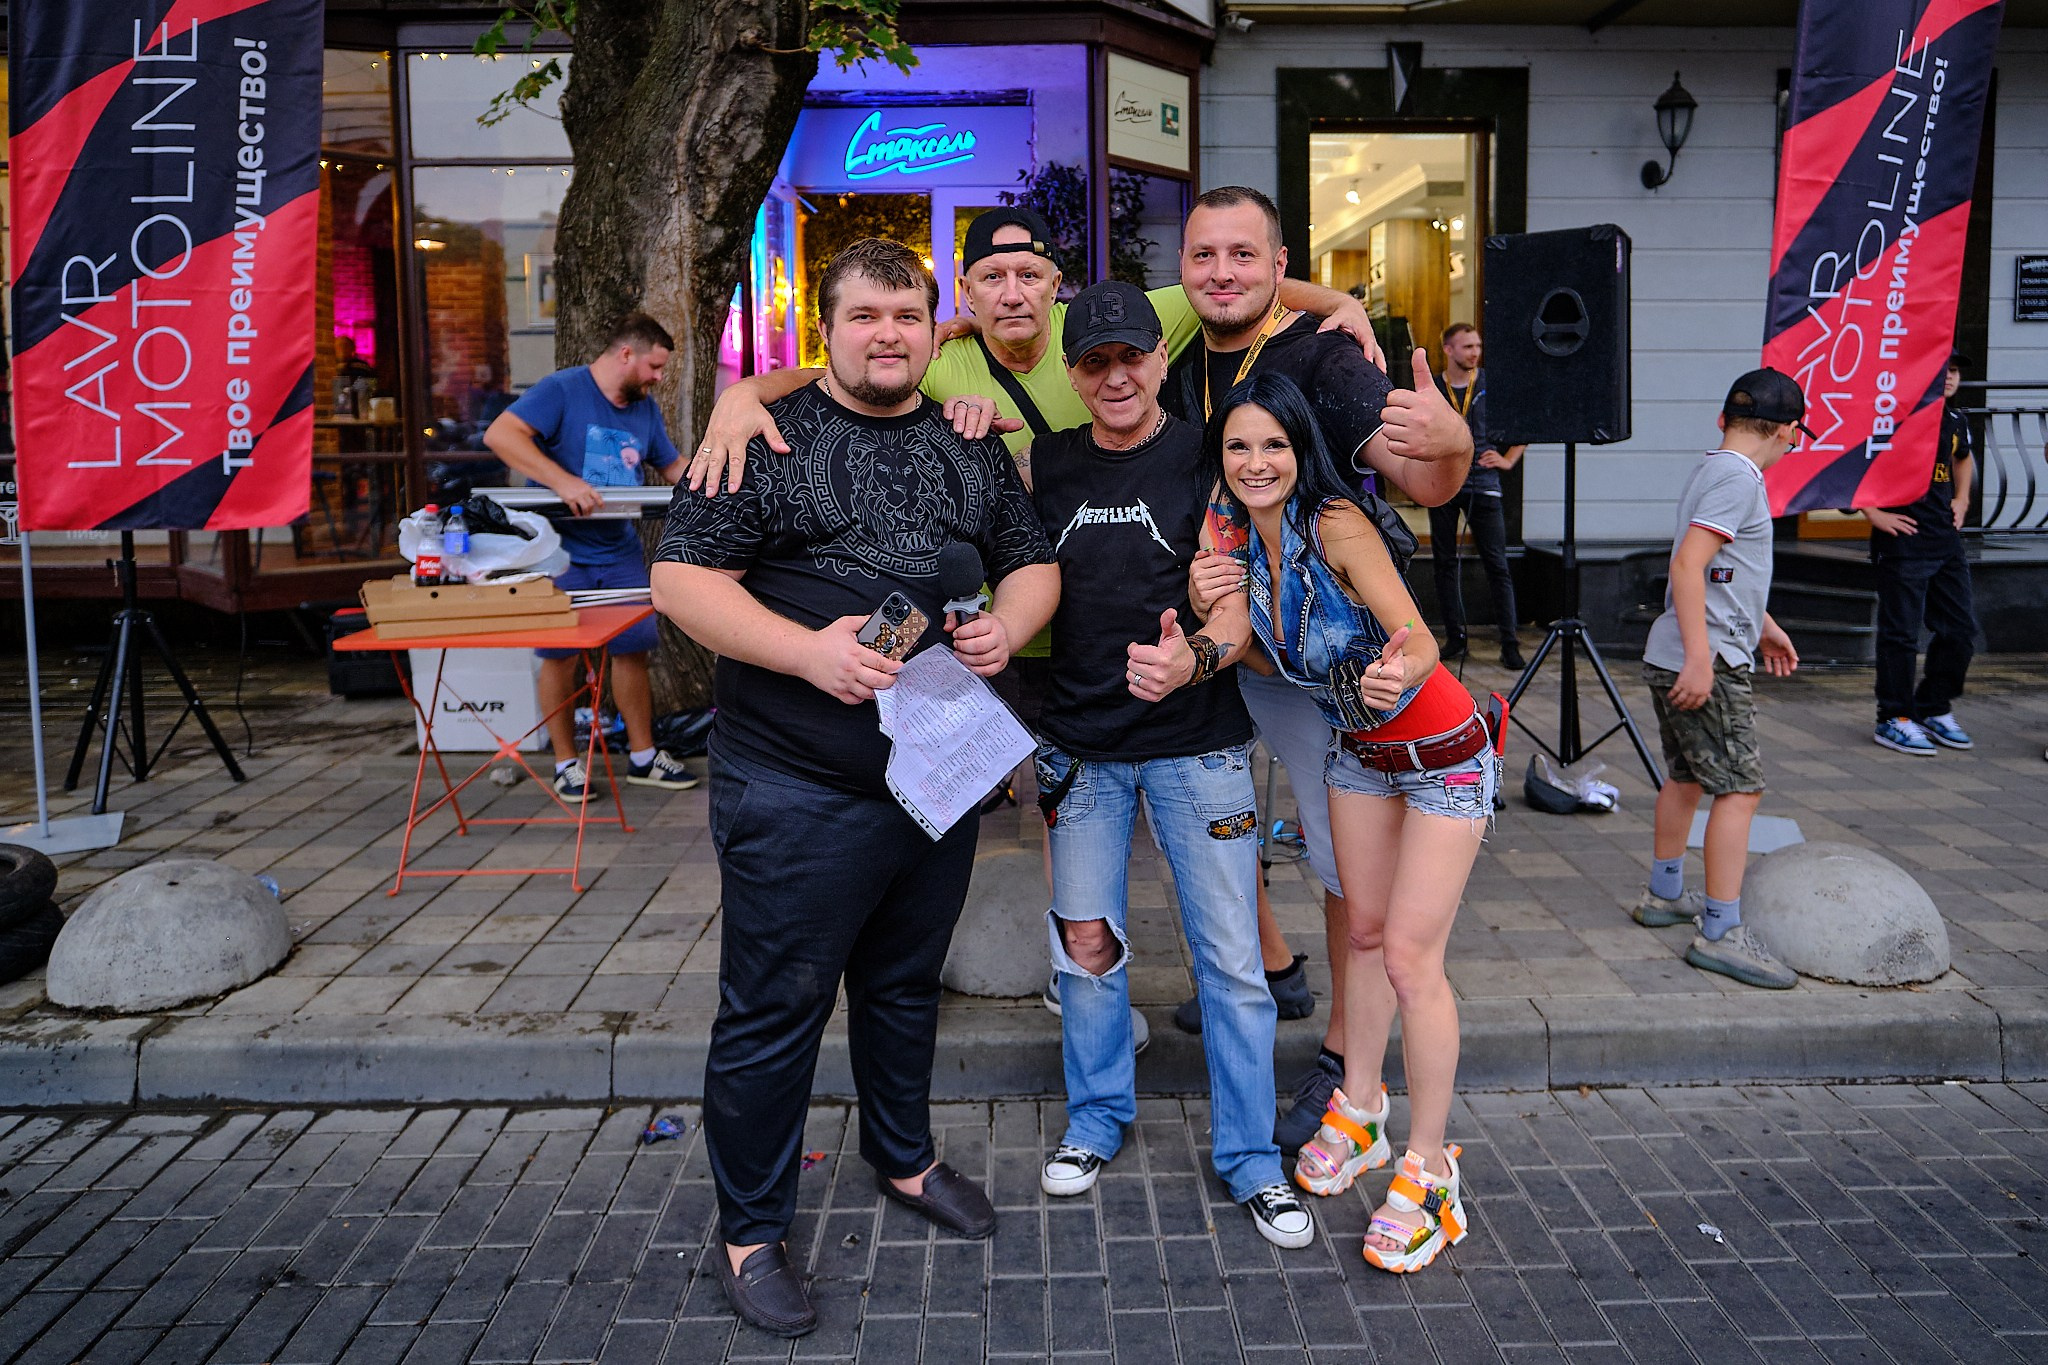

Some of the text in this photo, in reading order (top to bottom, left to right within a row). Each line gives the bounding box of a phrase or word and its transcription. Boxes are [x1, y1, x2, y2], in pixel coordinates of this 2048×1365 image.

[131, 18, 198, 466] MOTOLINE
[223, 37, 268, 475] Твое преимущество!
[1086, 291, 1127, 329] 13
[1810, 29, 1929, 452] MOTOLINE
[1865, 57, 1949, 459] Твое преимущество!
[61, 253, 121, 468] LAVR
[1055, 498, 1176, 556] METALLICA
[443, 702, 505, 713] LAVR
[1218, 812, 1250, 826] OUTLAW
